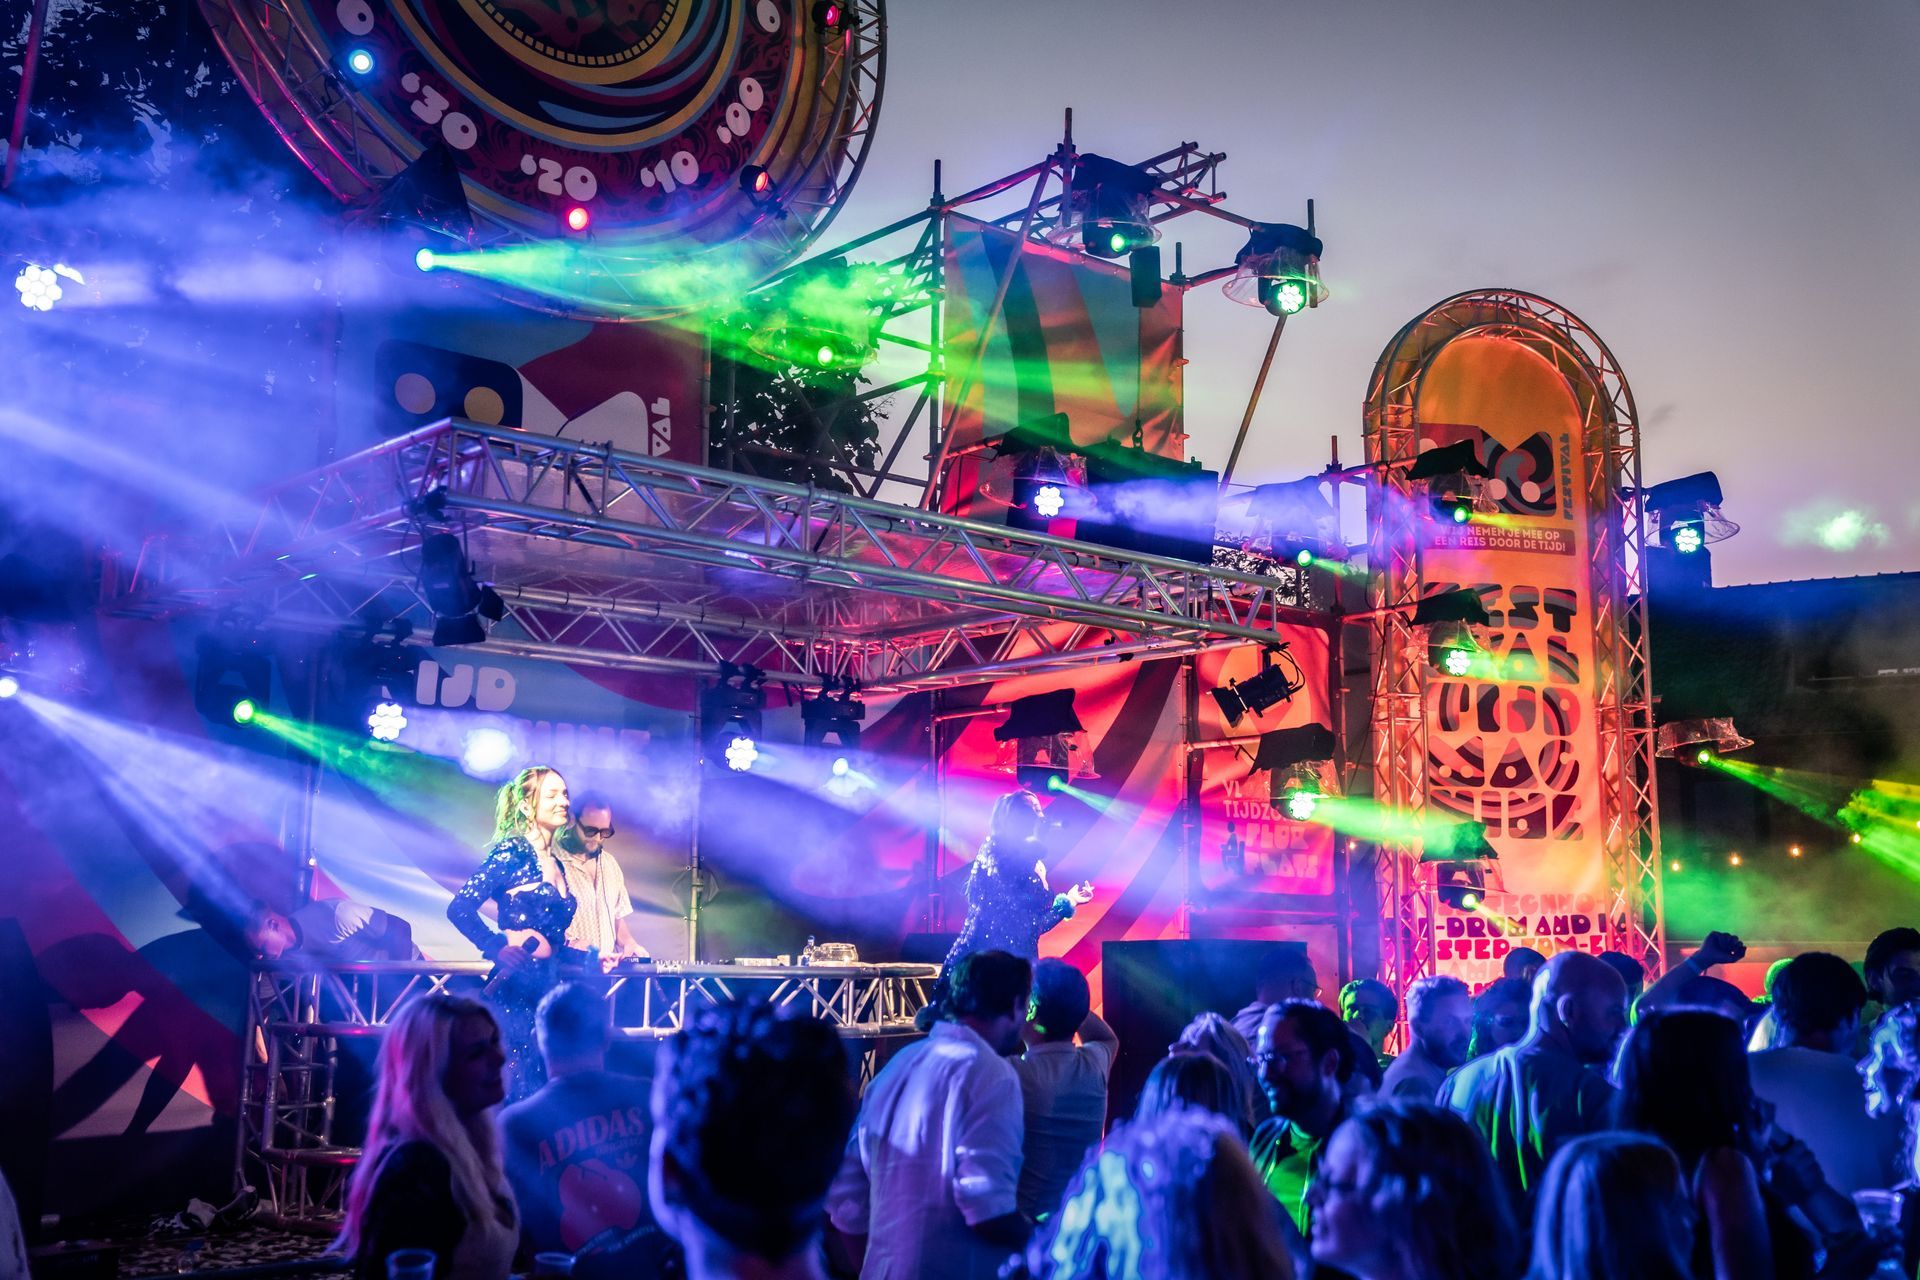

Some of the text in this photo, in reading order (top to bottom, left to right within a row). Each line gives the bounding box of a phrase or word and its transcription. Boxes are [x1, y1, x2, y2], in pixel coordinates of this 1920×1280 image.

[336, 0, 375, 36] 0
[650, 396, 672, 457] VAL
[1559, 432, 1574, 521] FESTIVAL
[1434, 536, 1566, 552] EEN REIS DOOR DE TIJD!
[1466, 526, 1506, 537] NEMEN
[1507, 528, 1521, 538] JE
[1522, 529, 1543, 540] MEE
[1544, 531, 1560, 541] OP
[415, 659, 517, 711] IJD
[1535, 914, 1592, 936] AND
[538, 1107, 645, 1177] ADIDAS
